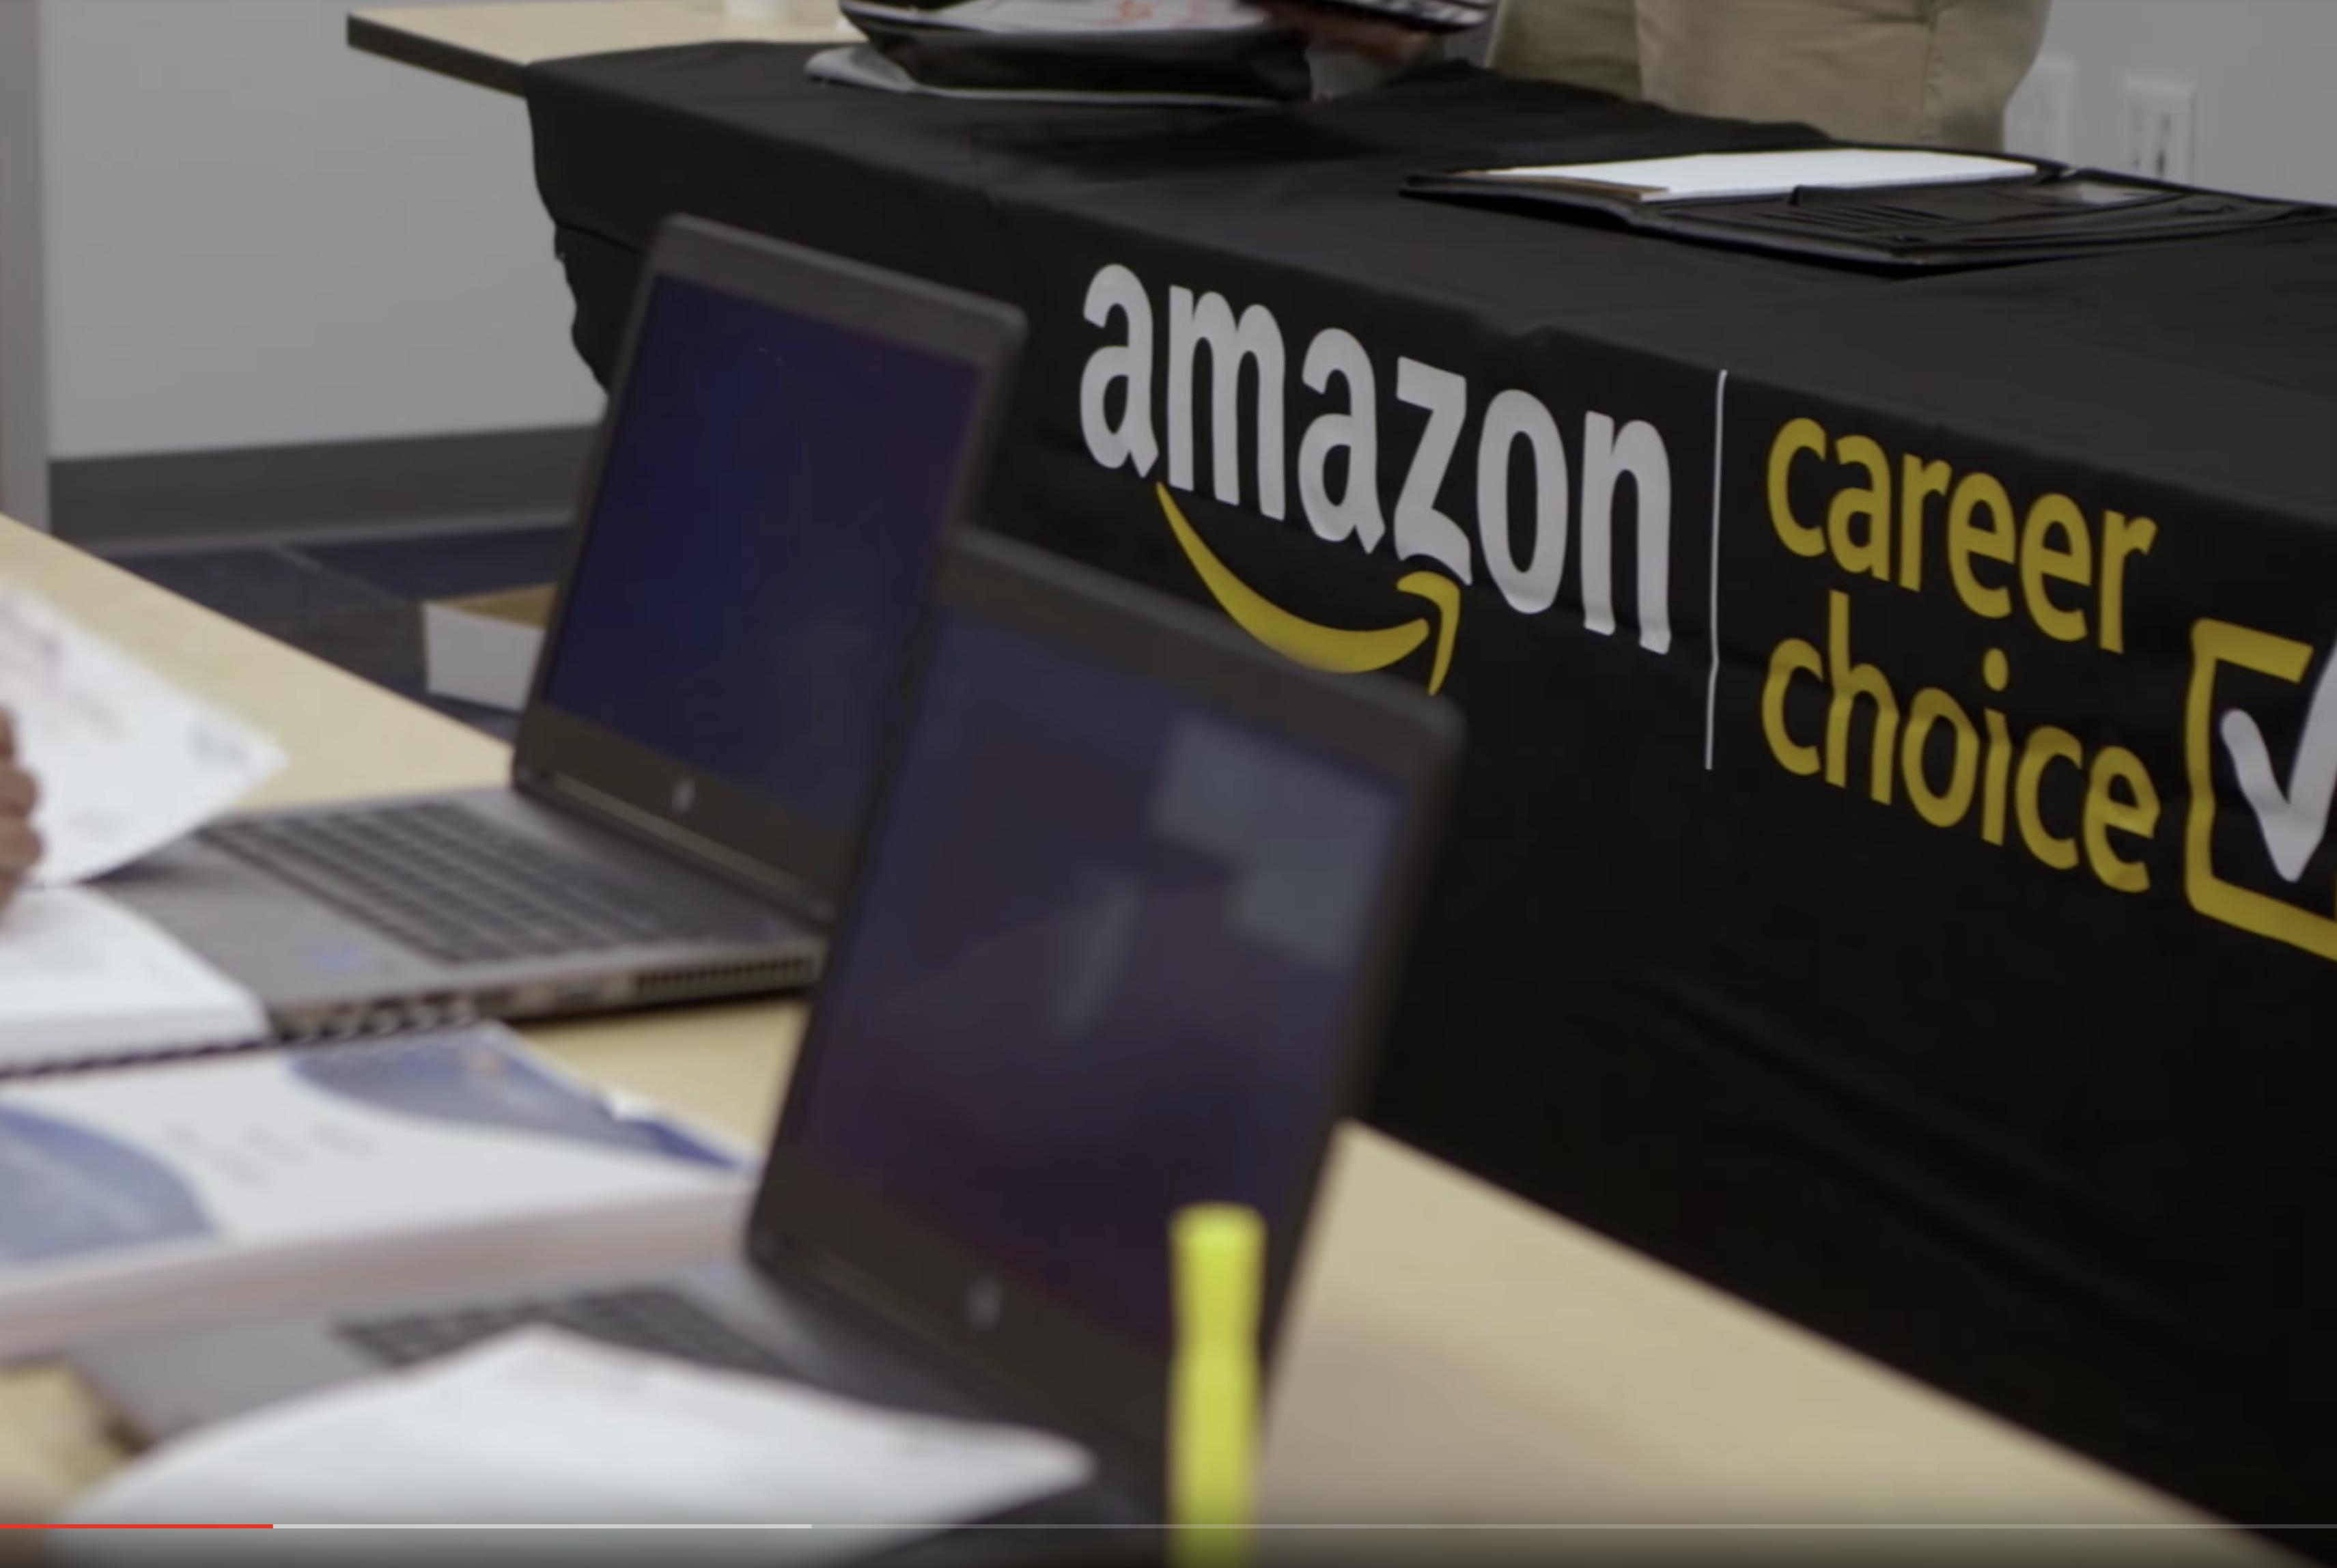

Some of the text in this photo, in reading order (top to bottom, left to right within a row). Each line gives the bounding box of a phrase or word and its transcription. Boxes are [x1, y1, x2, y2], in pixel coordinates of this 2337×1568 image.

[1080, 264, 1671, 654] amazon
[1767, 417, 2157, 653] career
[1762, 590, 2160, 893] choice
